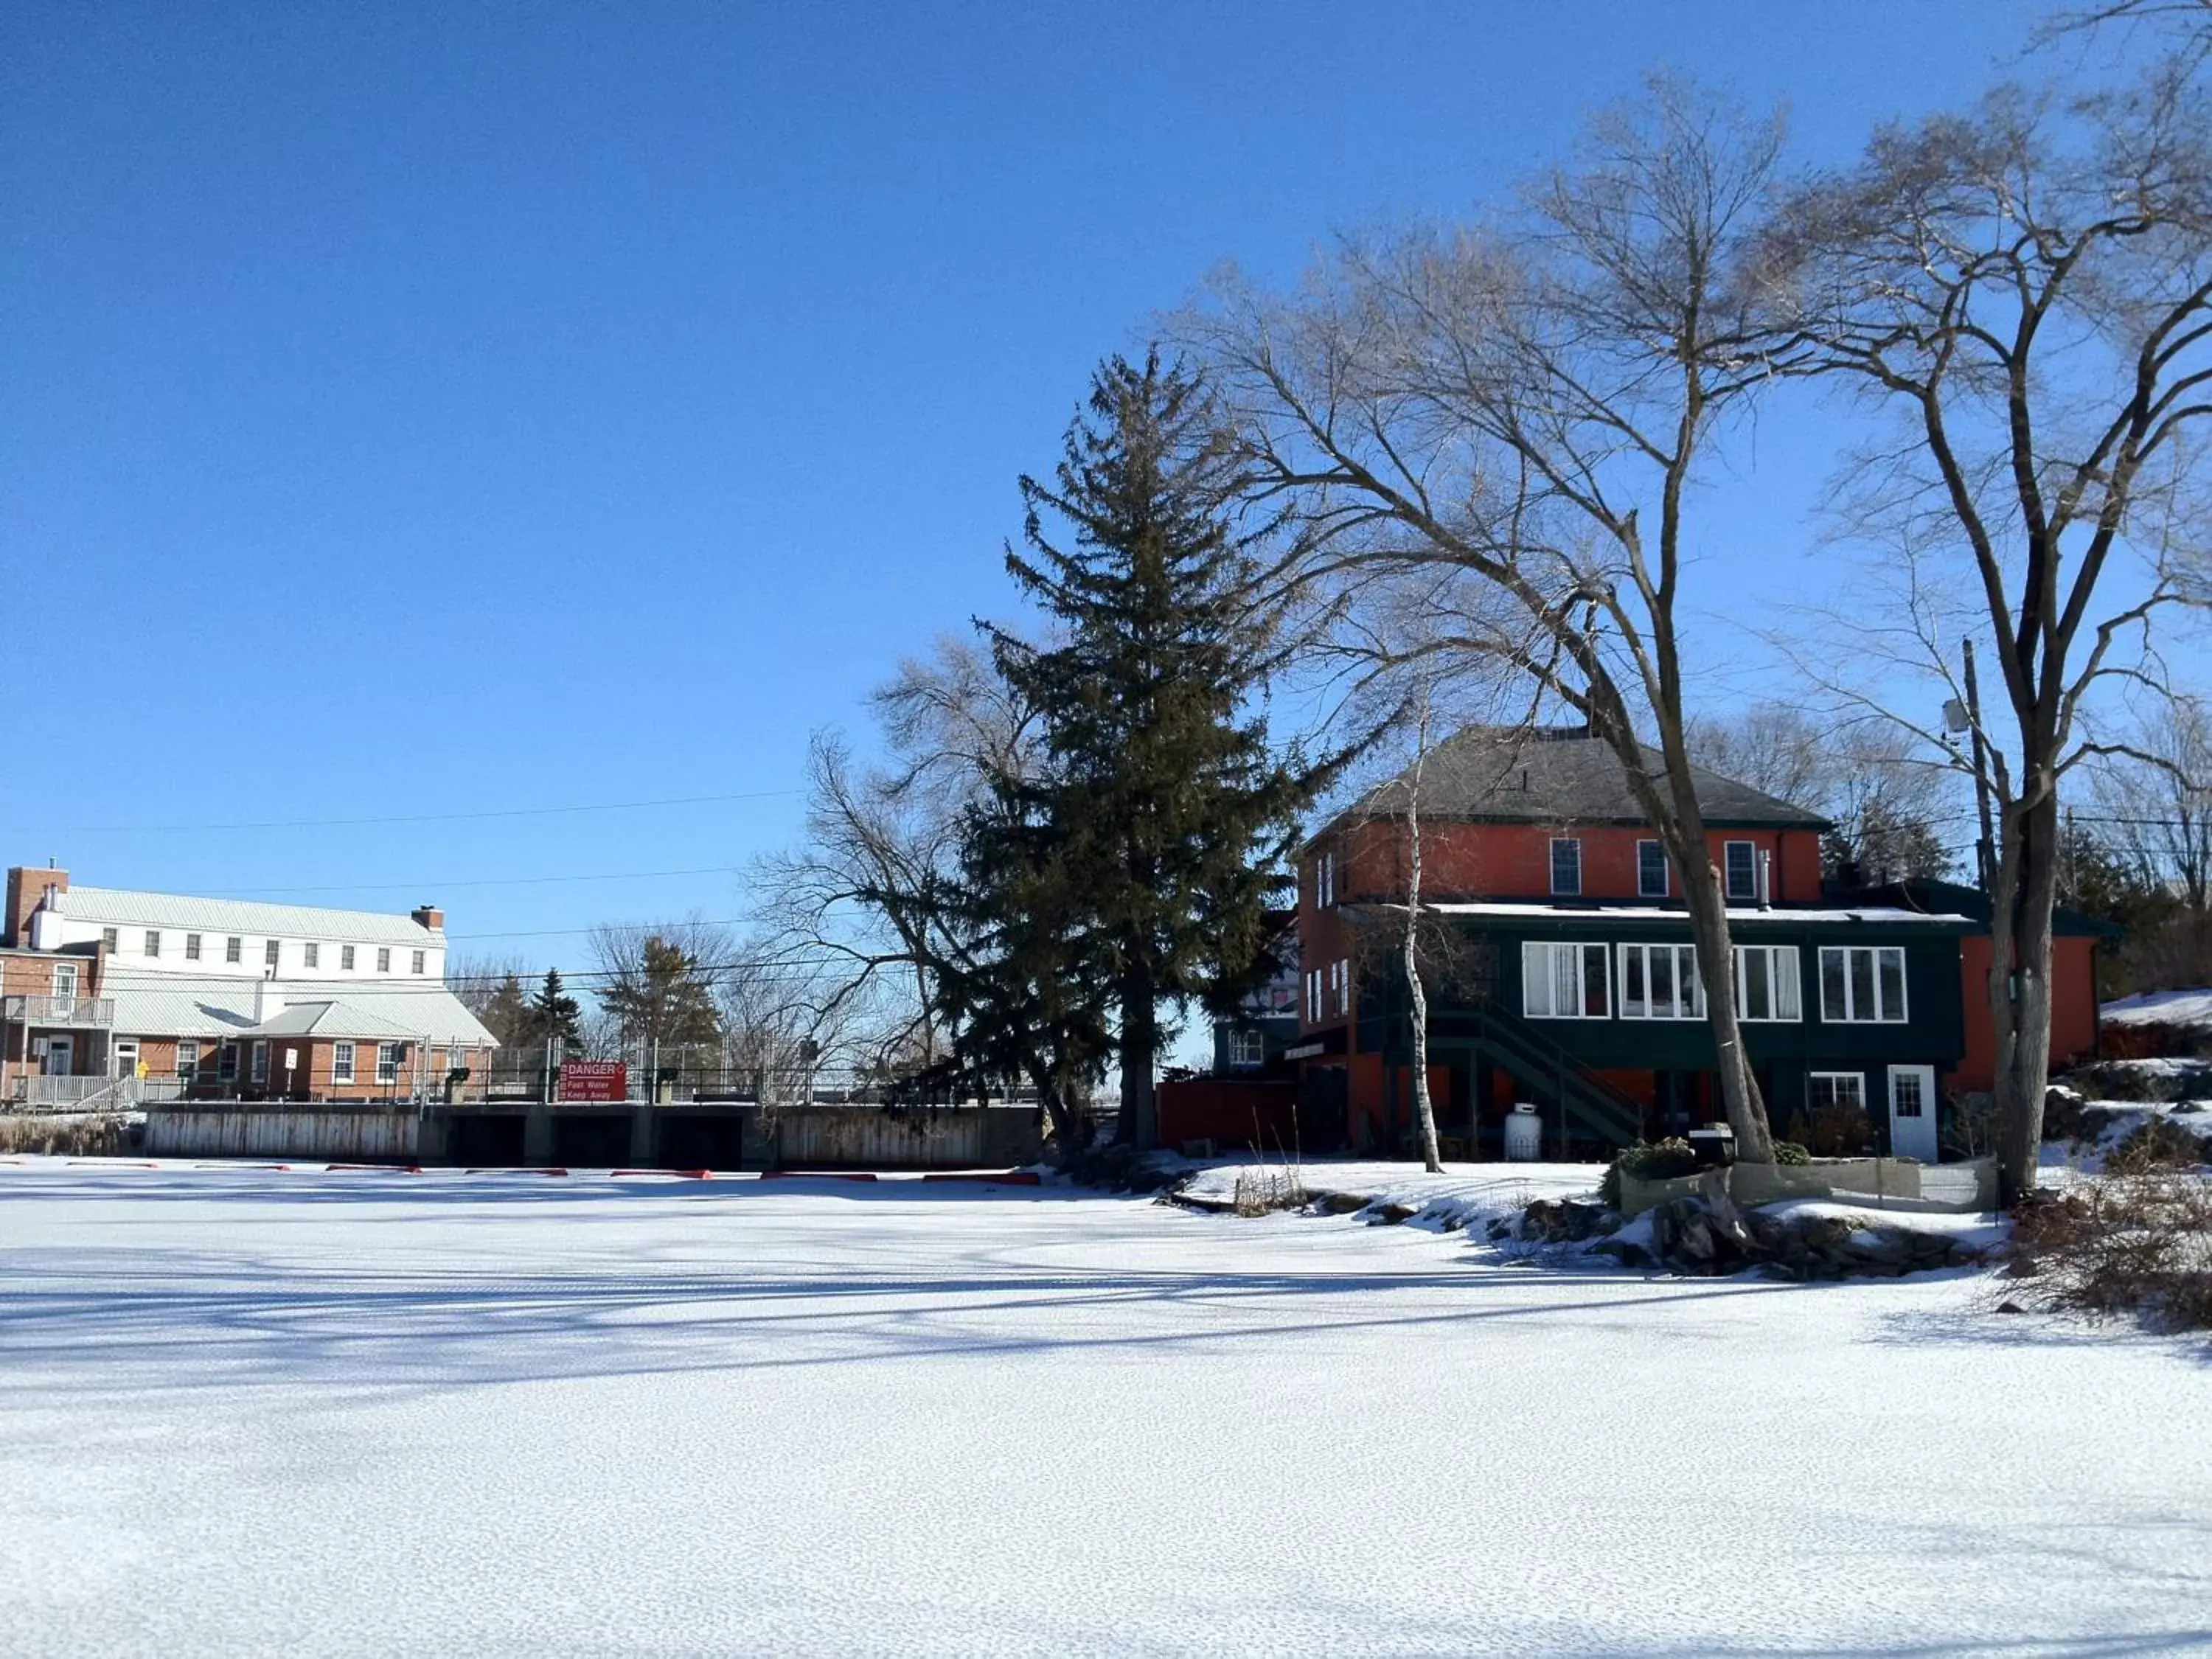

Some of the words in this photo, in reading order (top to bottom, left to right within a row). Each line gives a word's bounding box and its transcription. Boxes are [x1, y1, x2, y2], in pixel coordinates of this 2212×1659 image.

[568, 1064, 615, 1074] DANGER
[567, 1080, 584, 1088] Fast
[567, 1091, 586, 1099] Keep
[591, 1091, 611, 1100] Away
